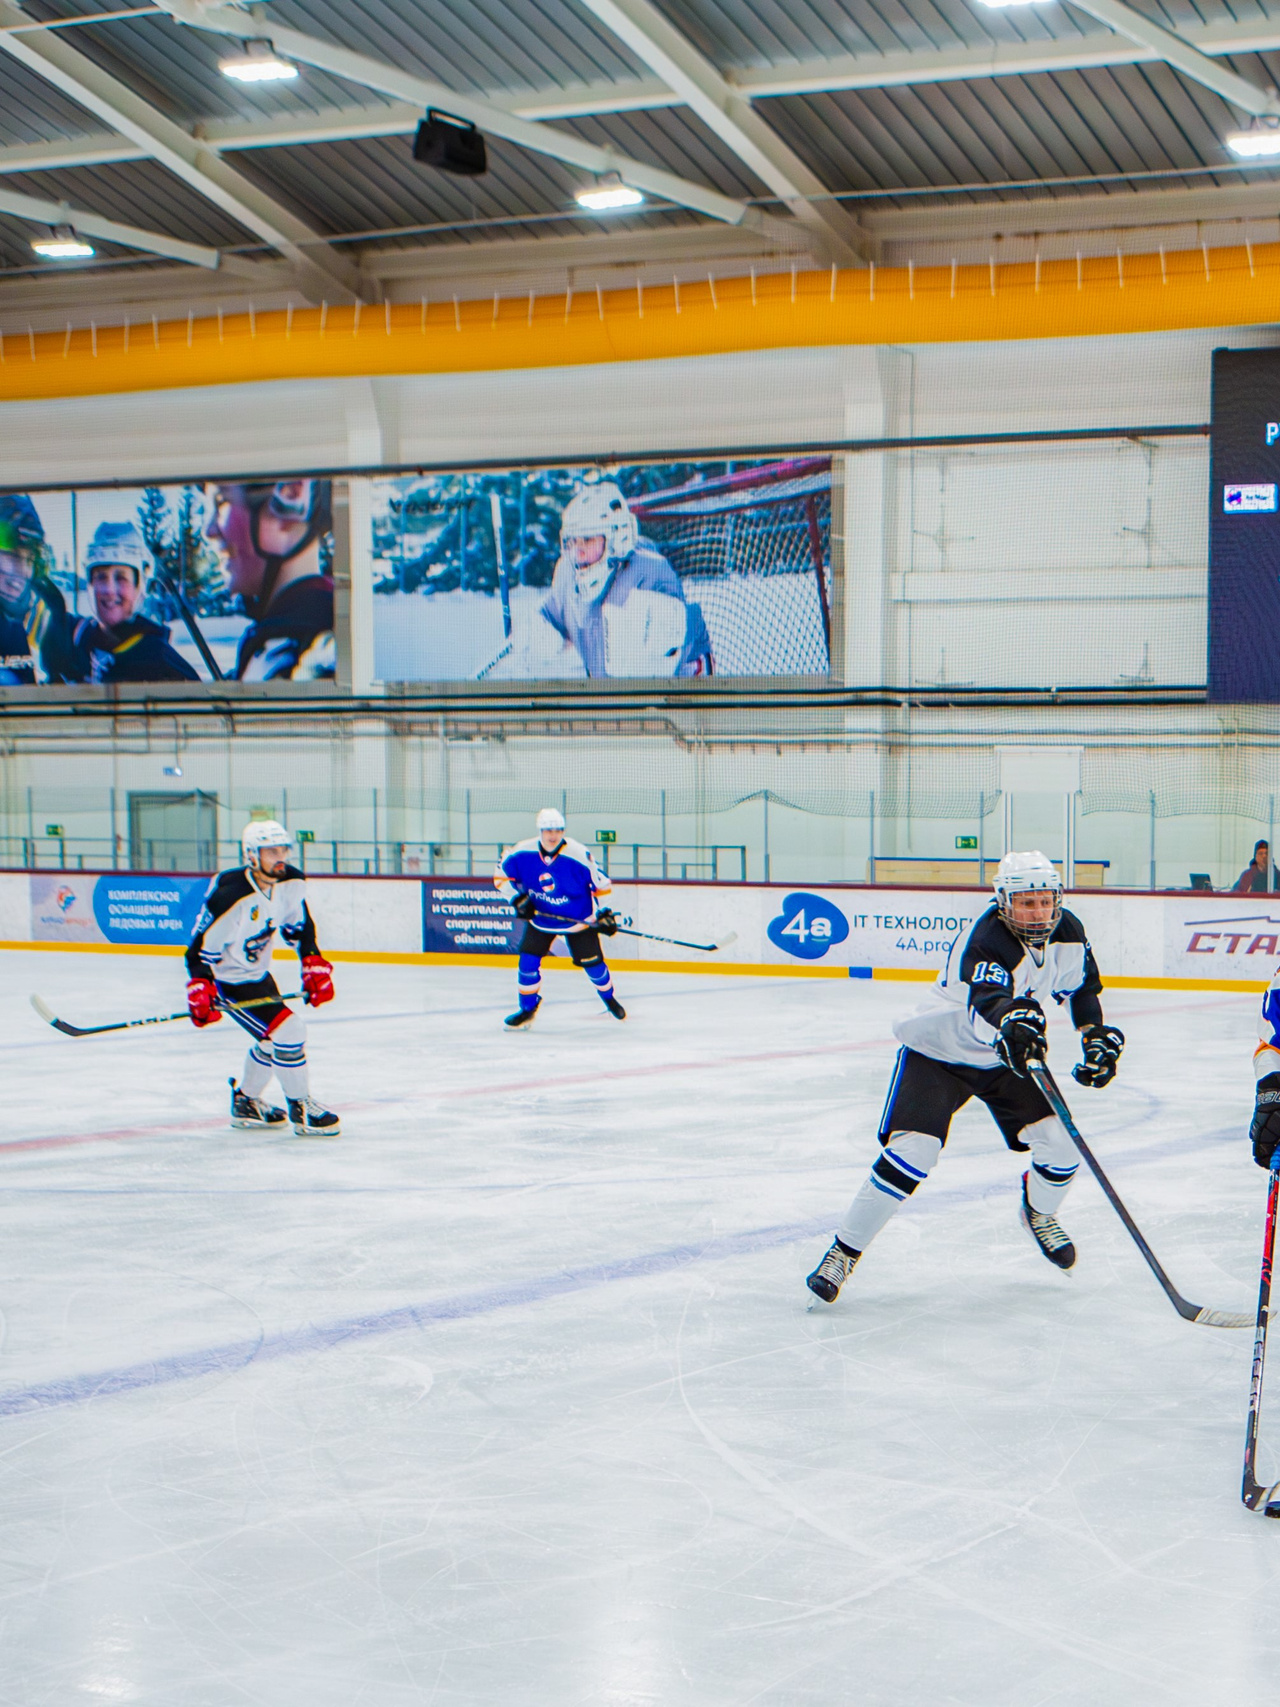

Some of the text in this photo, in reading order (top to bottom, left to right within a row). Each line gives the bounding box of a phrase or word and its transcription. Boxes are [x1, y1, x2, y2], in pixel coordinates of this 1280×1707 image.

[445, 919, 513, 932] спортивных
[854, 914, 973, 932] IT ТЕХНОЛОГ
[454, 933, 507, 946] объектов
